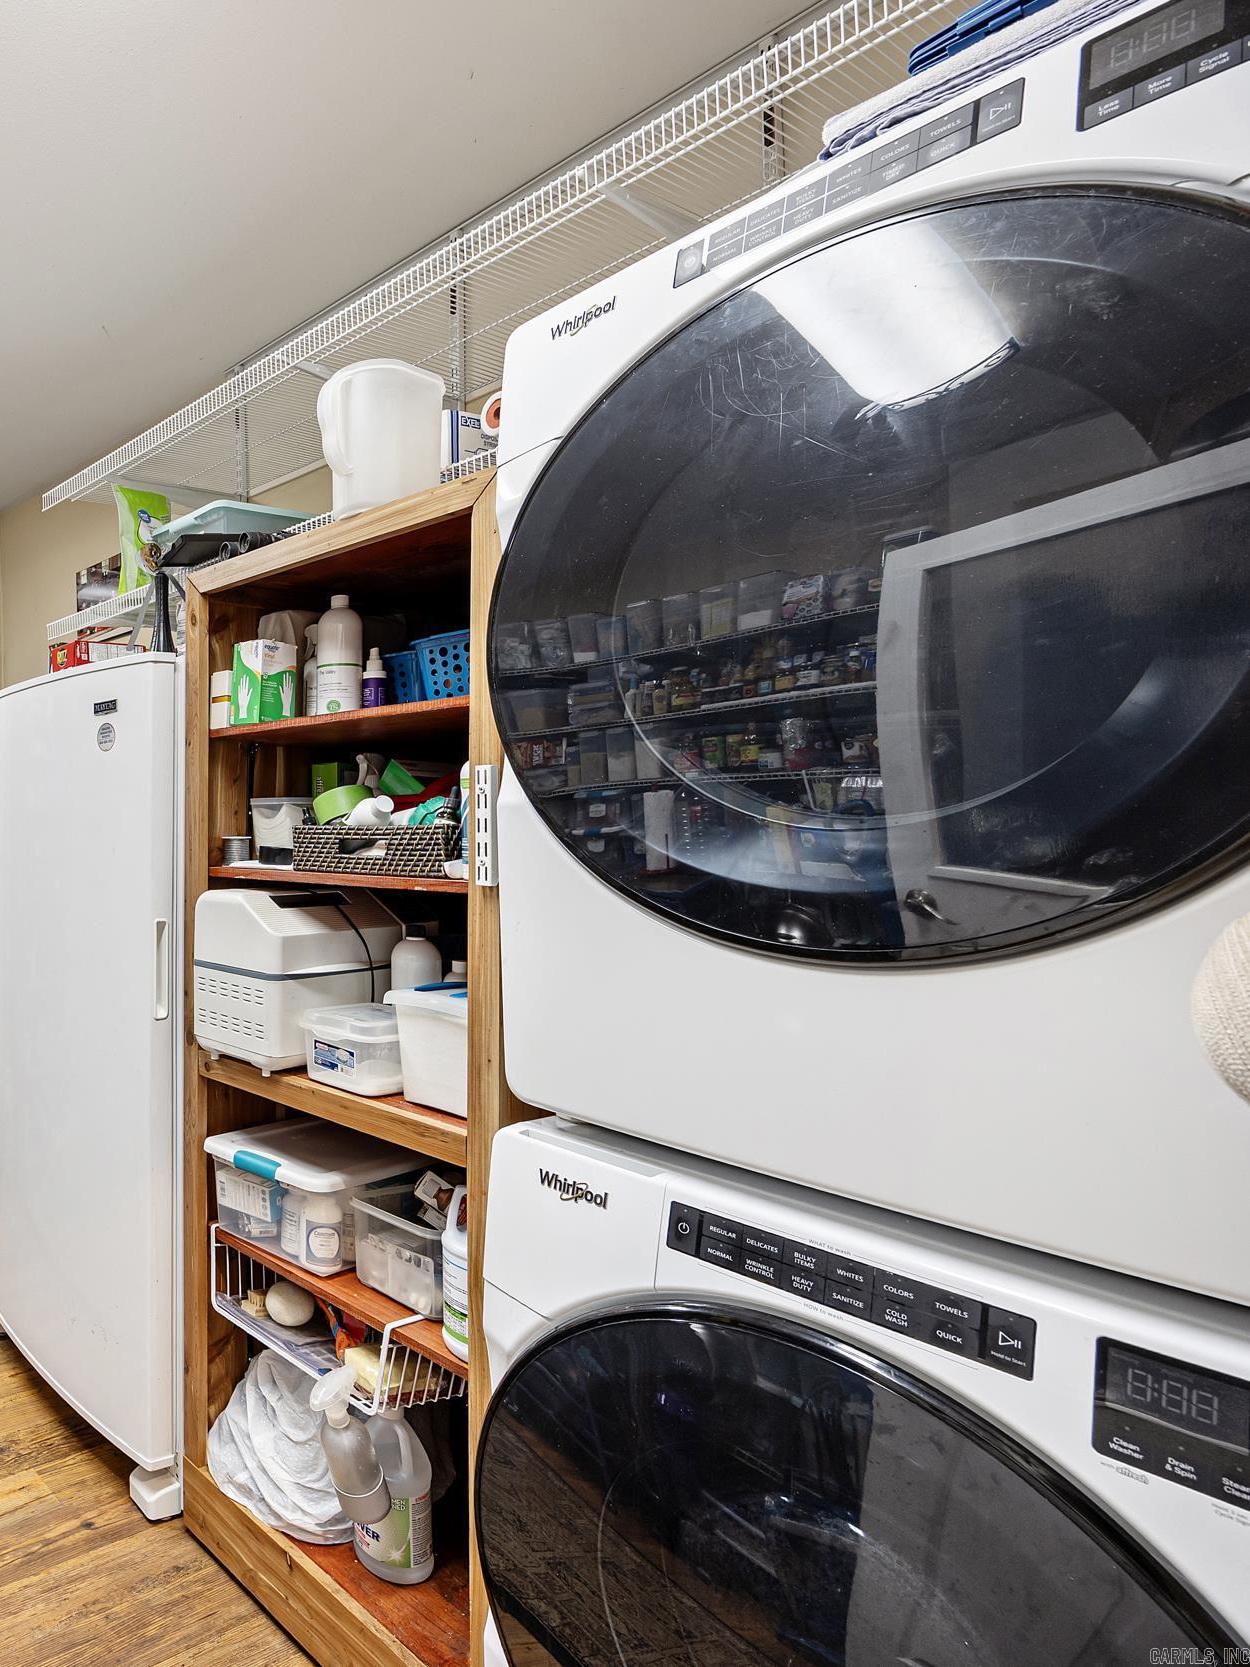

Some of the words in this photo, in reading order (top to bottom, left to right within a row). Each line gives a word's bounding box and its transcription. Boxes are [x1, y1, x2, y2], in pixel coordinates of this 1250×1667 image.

[1199, 56, 1230, 73] Signal
[1200, 51, 1229, 67] Cycle
[1148, 76, 1172, 90] More
[1149, 82, 1172, 94] Time
[1098, 99, 1119, 112] Less
[1098, 104, 1120, 116] Time
[930, 118, 962, 137] TOWELS
[881, 143, 910, 161] COLORS
[930, 142, 956, 157] QUICK
[836, 168, 862, 183] WHITES
[882, 163, 905, 177] TIMED
[795, 188, 817, 201] BULKY
[833, 186, 862, 203] SANITIZE
[750, 207, 781, 225] DELICATES
[793, 207, 814, 220] HEAVY
[794, 213, 812, 225] DUTY
[714, 228, 741, 244] REGULAR
[748, 231, 777, 247] CONTROL
[750, 225, 777, 242] WRINKLE
[712, 247, 738, 262] NORMAL
[551, 295, 616, 340] Whirlpool
[539, 1168, 608, 1209] Whirlpool
[709, 1225, 737, 1240] REGULAR
[746, 1238, 778, 1254] DELICATES
[808, 1239, 826, 1250] WHAT
[834, 1248, 851, 1256] wash
[707, 1247, 733, 1262] NORMAL
[794, 1251, 816, 1263] BULKY
[745, 1258, 775, 1272] WRINKLE
[794, 1258, 815, 1269] ITEMS
[744, 1264, 775, 1280] CONTROL
[836, 1268, 864, 1283] WHITES
[791, 1275, 814, 1287] HEAVY
[792, 1281, 812, 1293] DUTY
[883, 1284, 915, 1300] COLORS
[832, 1292, 865, 1309] SANITIZE
[803, 1302, 820, 1312] HOW
[827, 1311, 845, 1321] wash
[886, 1308, 908, 1320] COLD
[935, 1302, 969, 1319] TOWELS
[885, 1314, 908, 1328] WASH
[936, 1329, 963, 1345] QUICK
[991, 1350, 1005, 1358] Hold
[1011, 1356, 1026, 1366] Start
[1108, 1441, 1145, 1460] Washer
[1112, 1436, 1141, 1452] Clean
[1164, 1463, 1172, 1471] &
[1173, 1467, 1197, 1481] Spin
[1167, 1456, 1195, 1472] Drain
[1116, 1466, 1149, 1485] affresh
